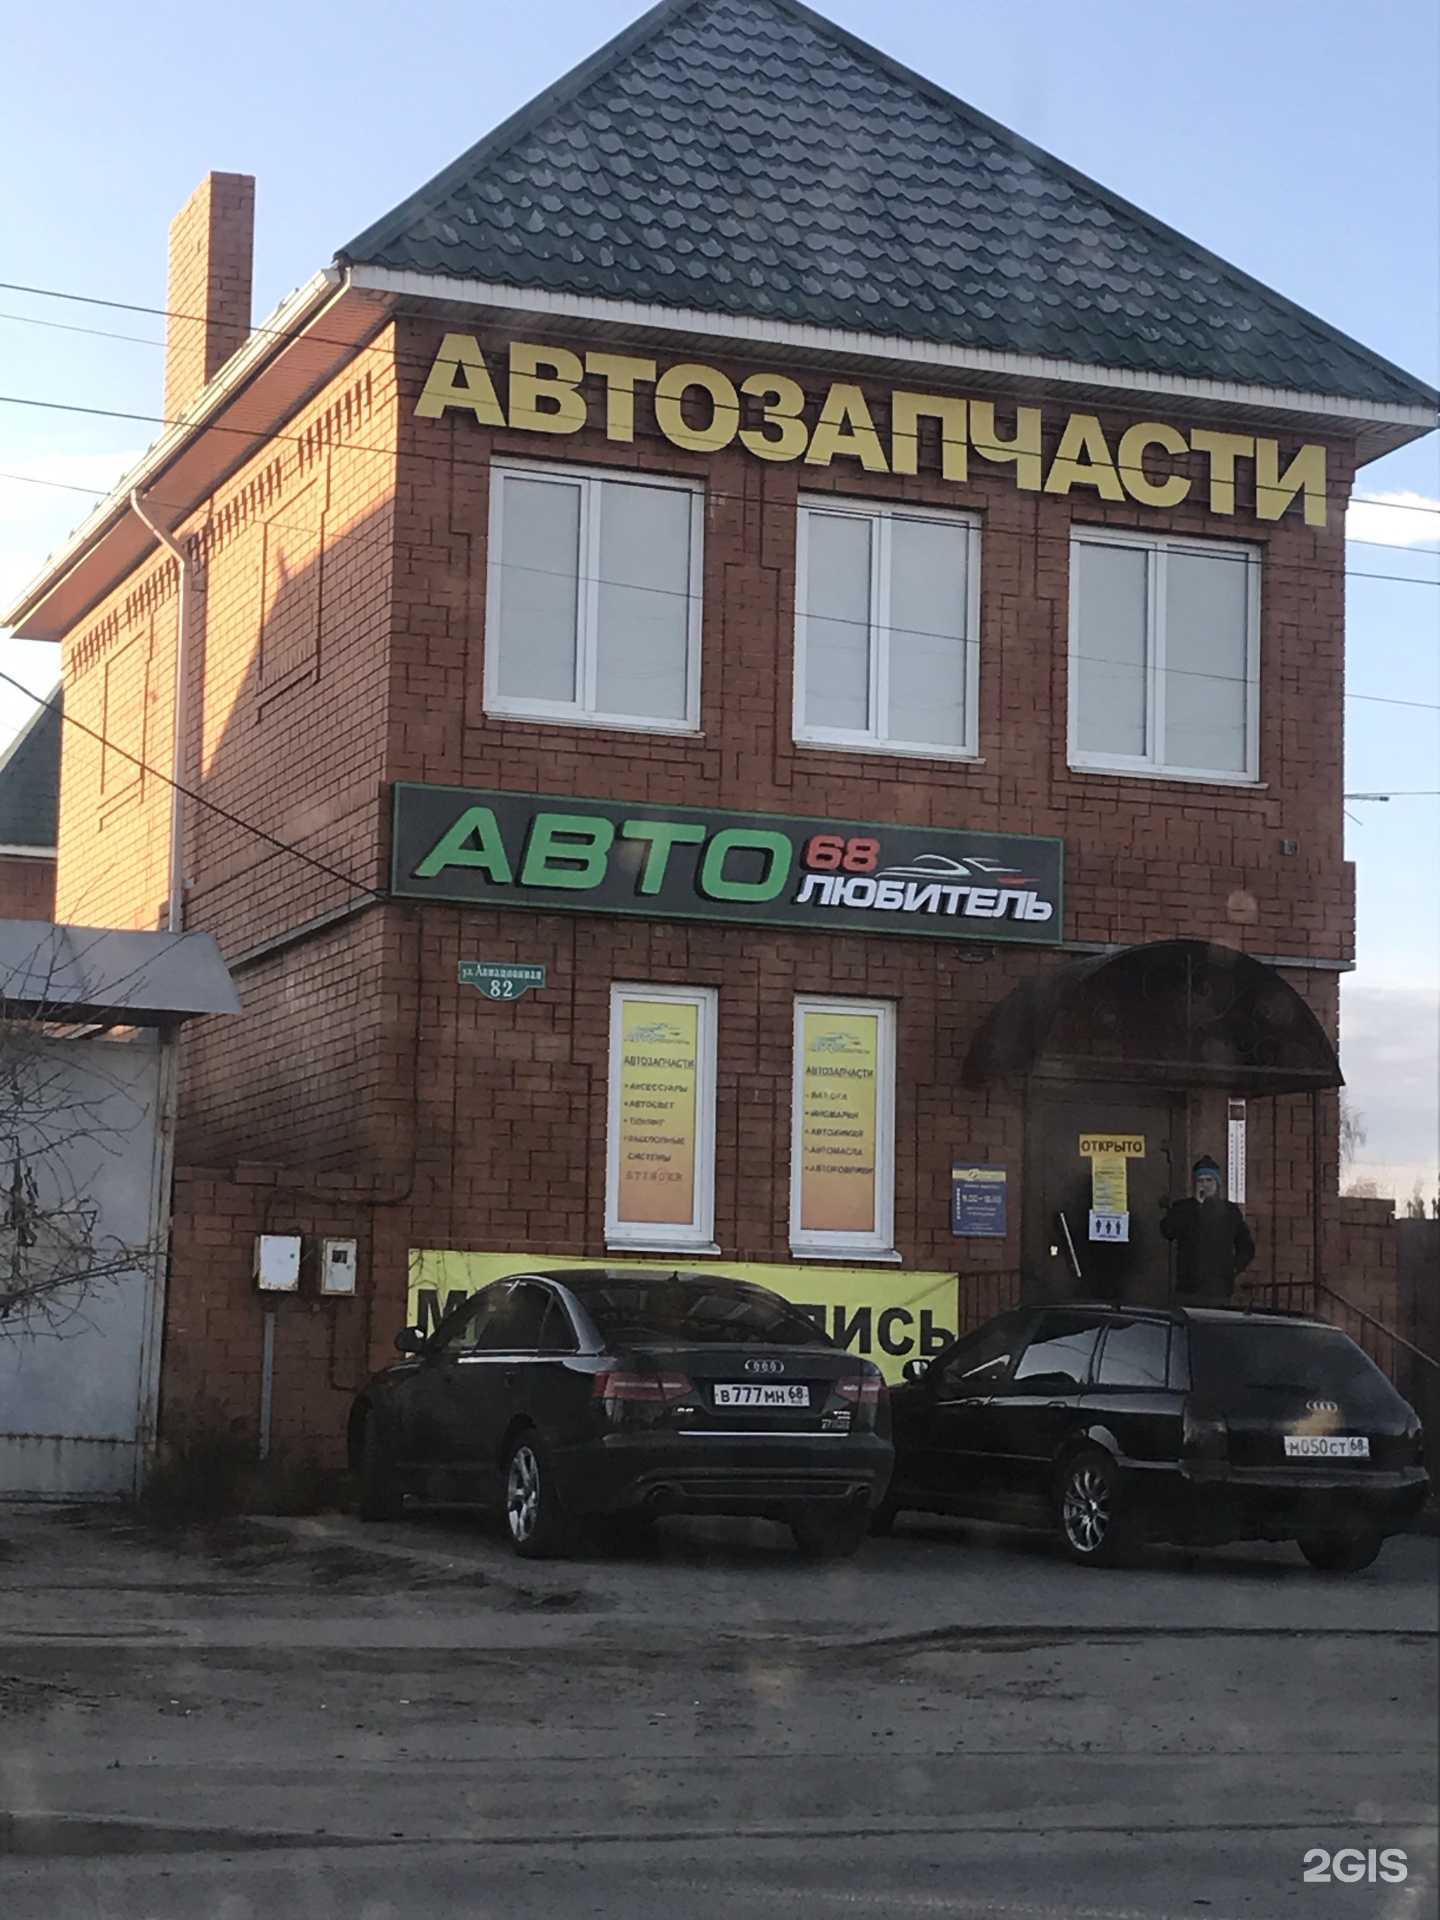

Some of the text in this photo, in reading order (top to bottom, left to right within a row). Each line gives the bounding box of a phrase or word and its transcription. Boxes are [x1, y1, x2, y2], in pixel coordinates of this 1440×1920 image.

[413, 333, 1327, 528] АВТОЗАПЧАСТИ
[414, 806, 793, 901] АВТО
[806, 835, 882, 873] 68
[797, 873, 1054, 922] ЛЮБИТЕЛЬ
[490, 979, 513, 997] 82
[624, 1055, 695, 1071] АВТОЗАПЧАСТИ
[806, 1065, 874, 1080] АВТОЗАПЧАСТИ
[1081, 1140, 1143, 1153] ОТКРЫТО
